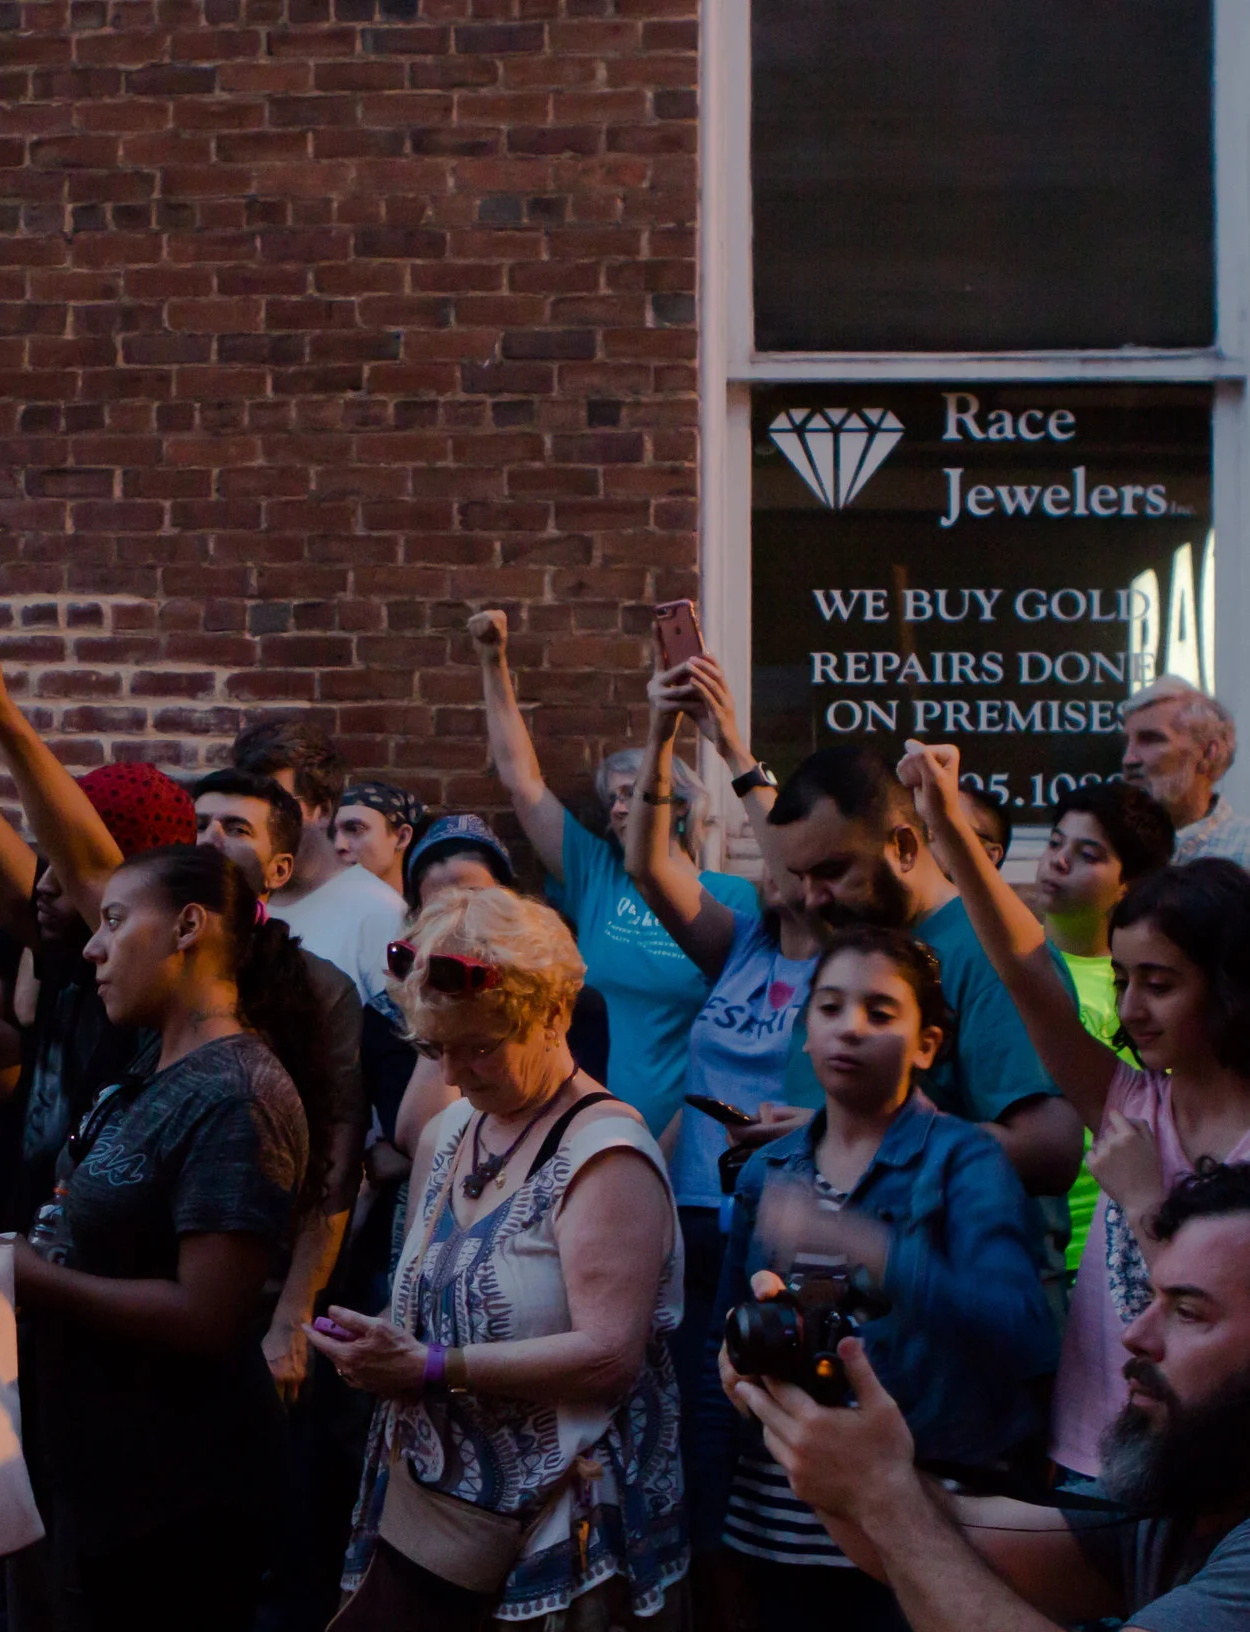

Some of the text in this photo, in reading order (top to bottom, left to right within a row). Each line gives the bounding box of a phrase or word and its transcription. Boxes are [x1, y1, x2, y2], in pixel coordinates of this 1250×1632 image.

[941, 391, 1077, 442] Race
[940, 466, 1167, 528] Jewelers
[811, 587, 1152, 623] WE BUY GOLD
[810, 651, 1157, 685] REPAIRS DONE
[826, 700, 899, 734] ON
